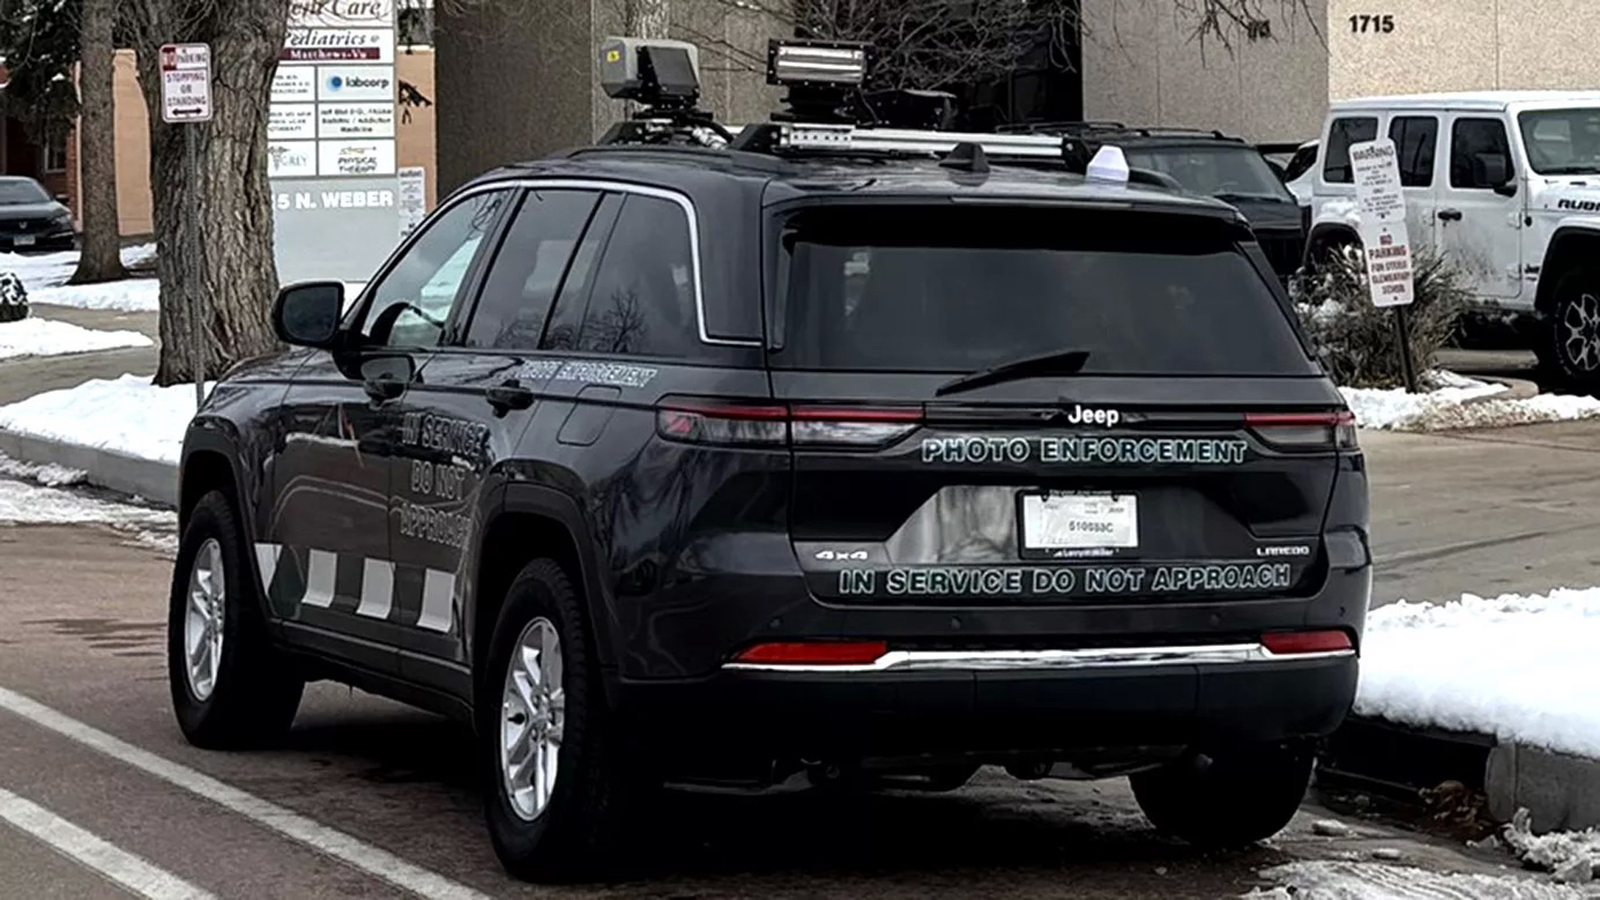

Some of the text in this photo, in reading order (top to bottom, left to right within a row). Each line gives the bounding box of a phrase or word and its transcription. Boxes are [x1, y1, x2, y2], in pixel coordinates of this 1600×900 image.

[1349, 14, 1395, 33] 1715
[345, 76, 389, 88] labcorp
[296, 192, 317, 209] N.
[322, 190, 393, 208] WEBER
[1368, 245, 1407, 260] PARKING
[1068, 404, 1119, 428] Jeep
[922, 438, 1248, 463] PHOTO ENFORCEMENT
[411, 459, 466, 501] DO NOT
[839, 563, 1290, 594] IN SERVICE DO NOT APPROACH
